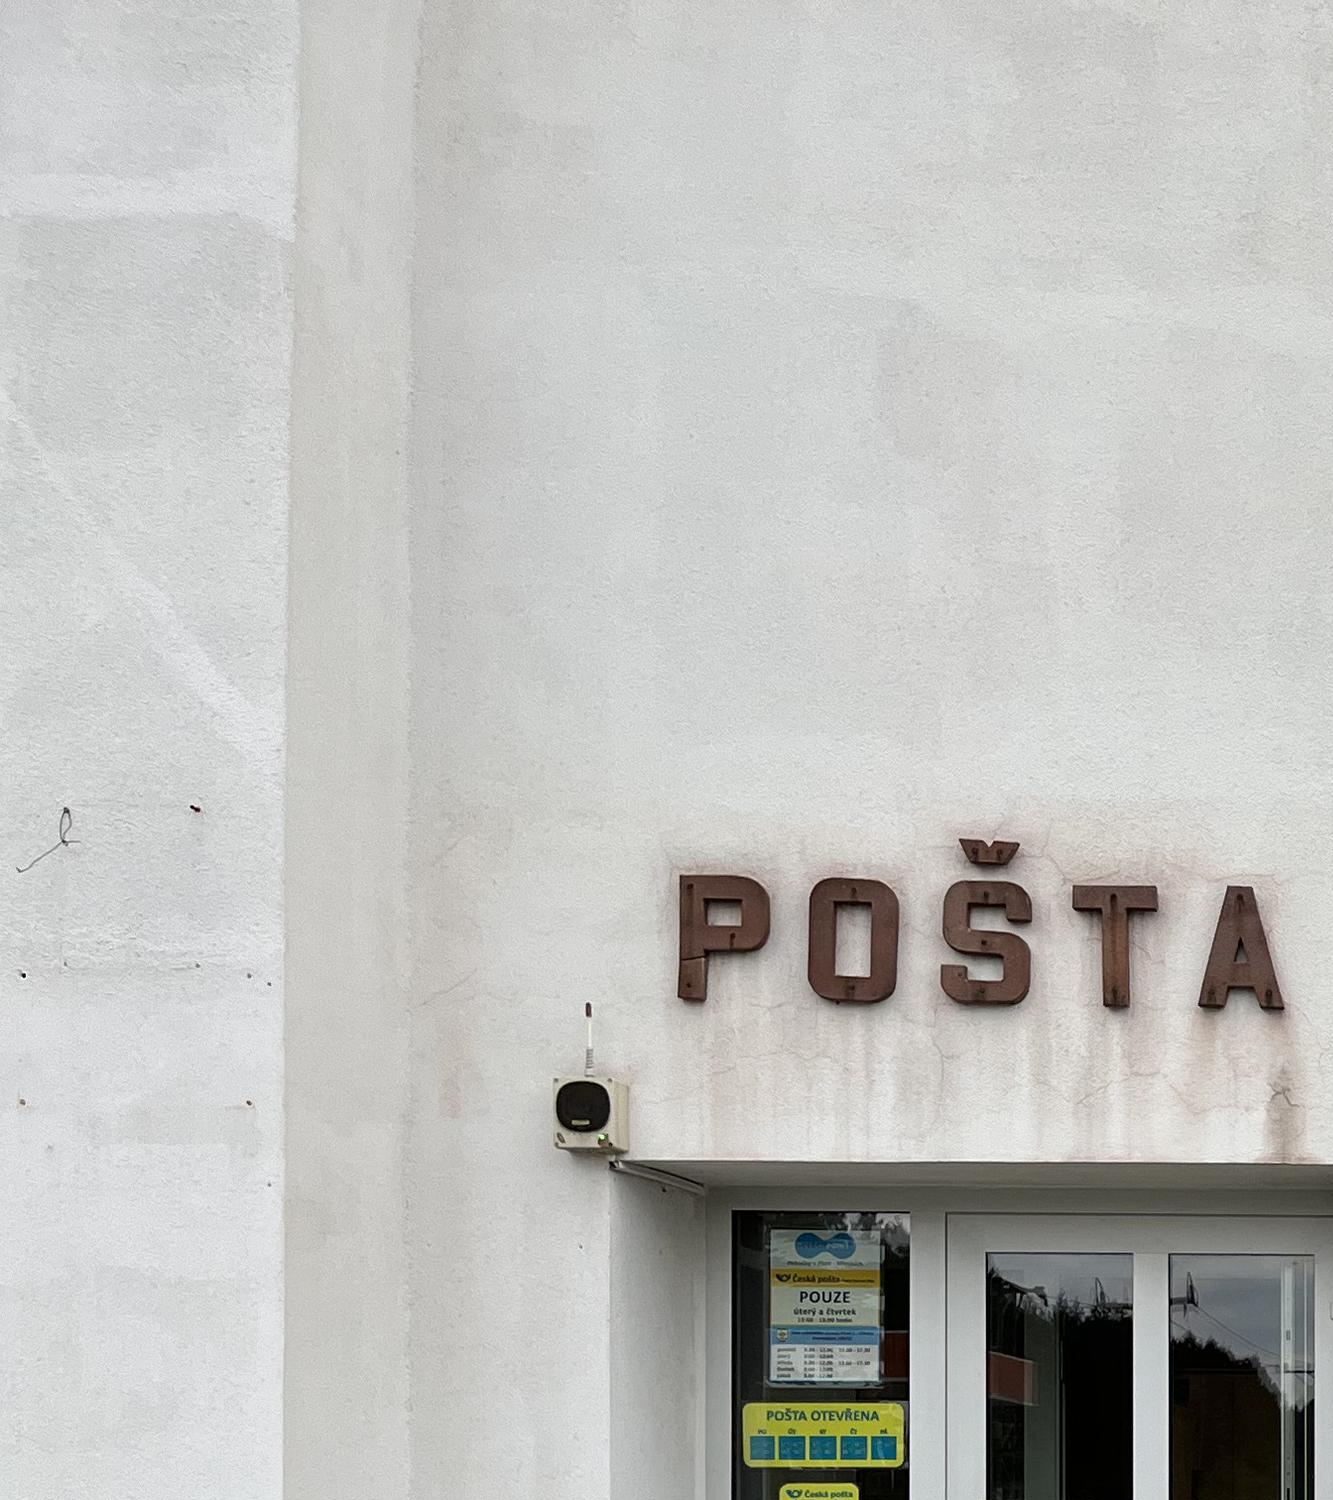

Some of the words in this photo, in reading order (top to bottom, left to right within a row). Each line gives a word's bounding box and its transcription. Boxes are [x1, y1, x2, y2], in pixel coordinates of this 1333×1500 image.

[677, 837, 1286, 1010] POŠTA
[799, 1291, 851, 1304] POUZE
[793, 1307, 817, 1316] úterý
[826, 1307, 857, 1316] čtvrtek
[766, 1408, 808, 1422] POŠTA
[810, 1408, 880, 1422] OTEVŘENA
[804, 1489, 829, 1498] Česká
[830, 1490, 854, 1499] pošta
